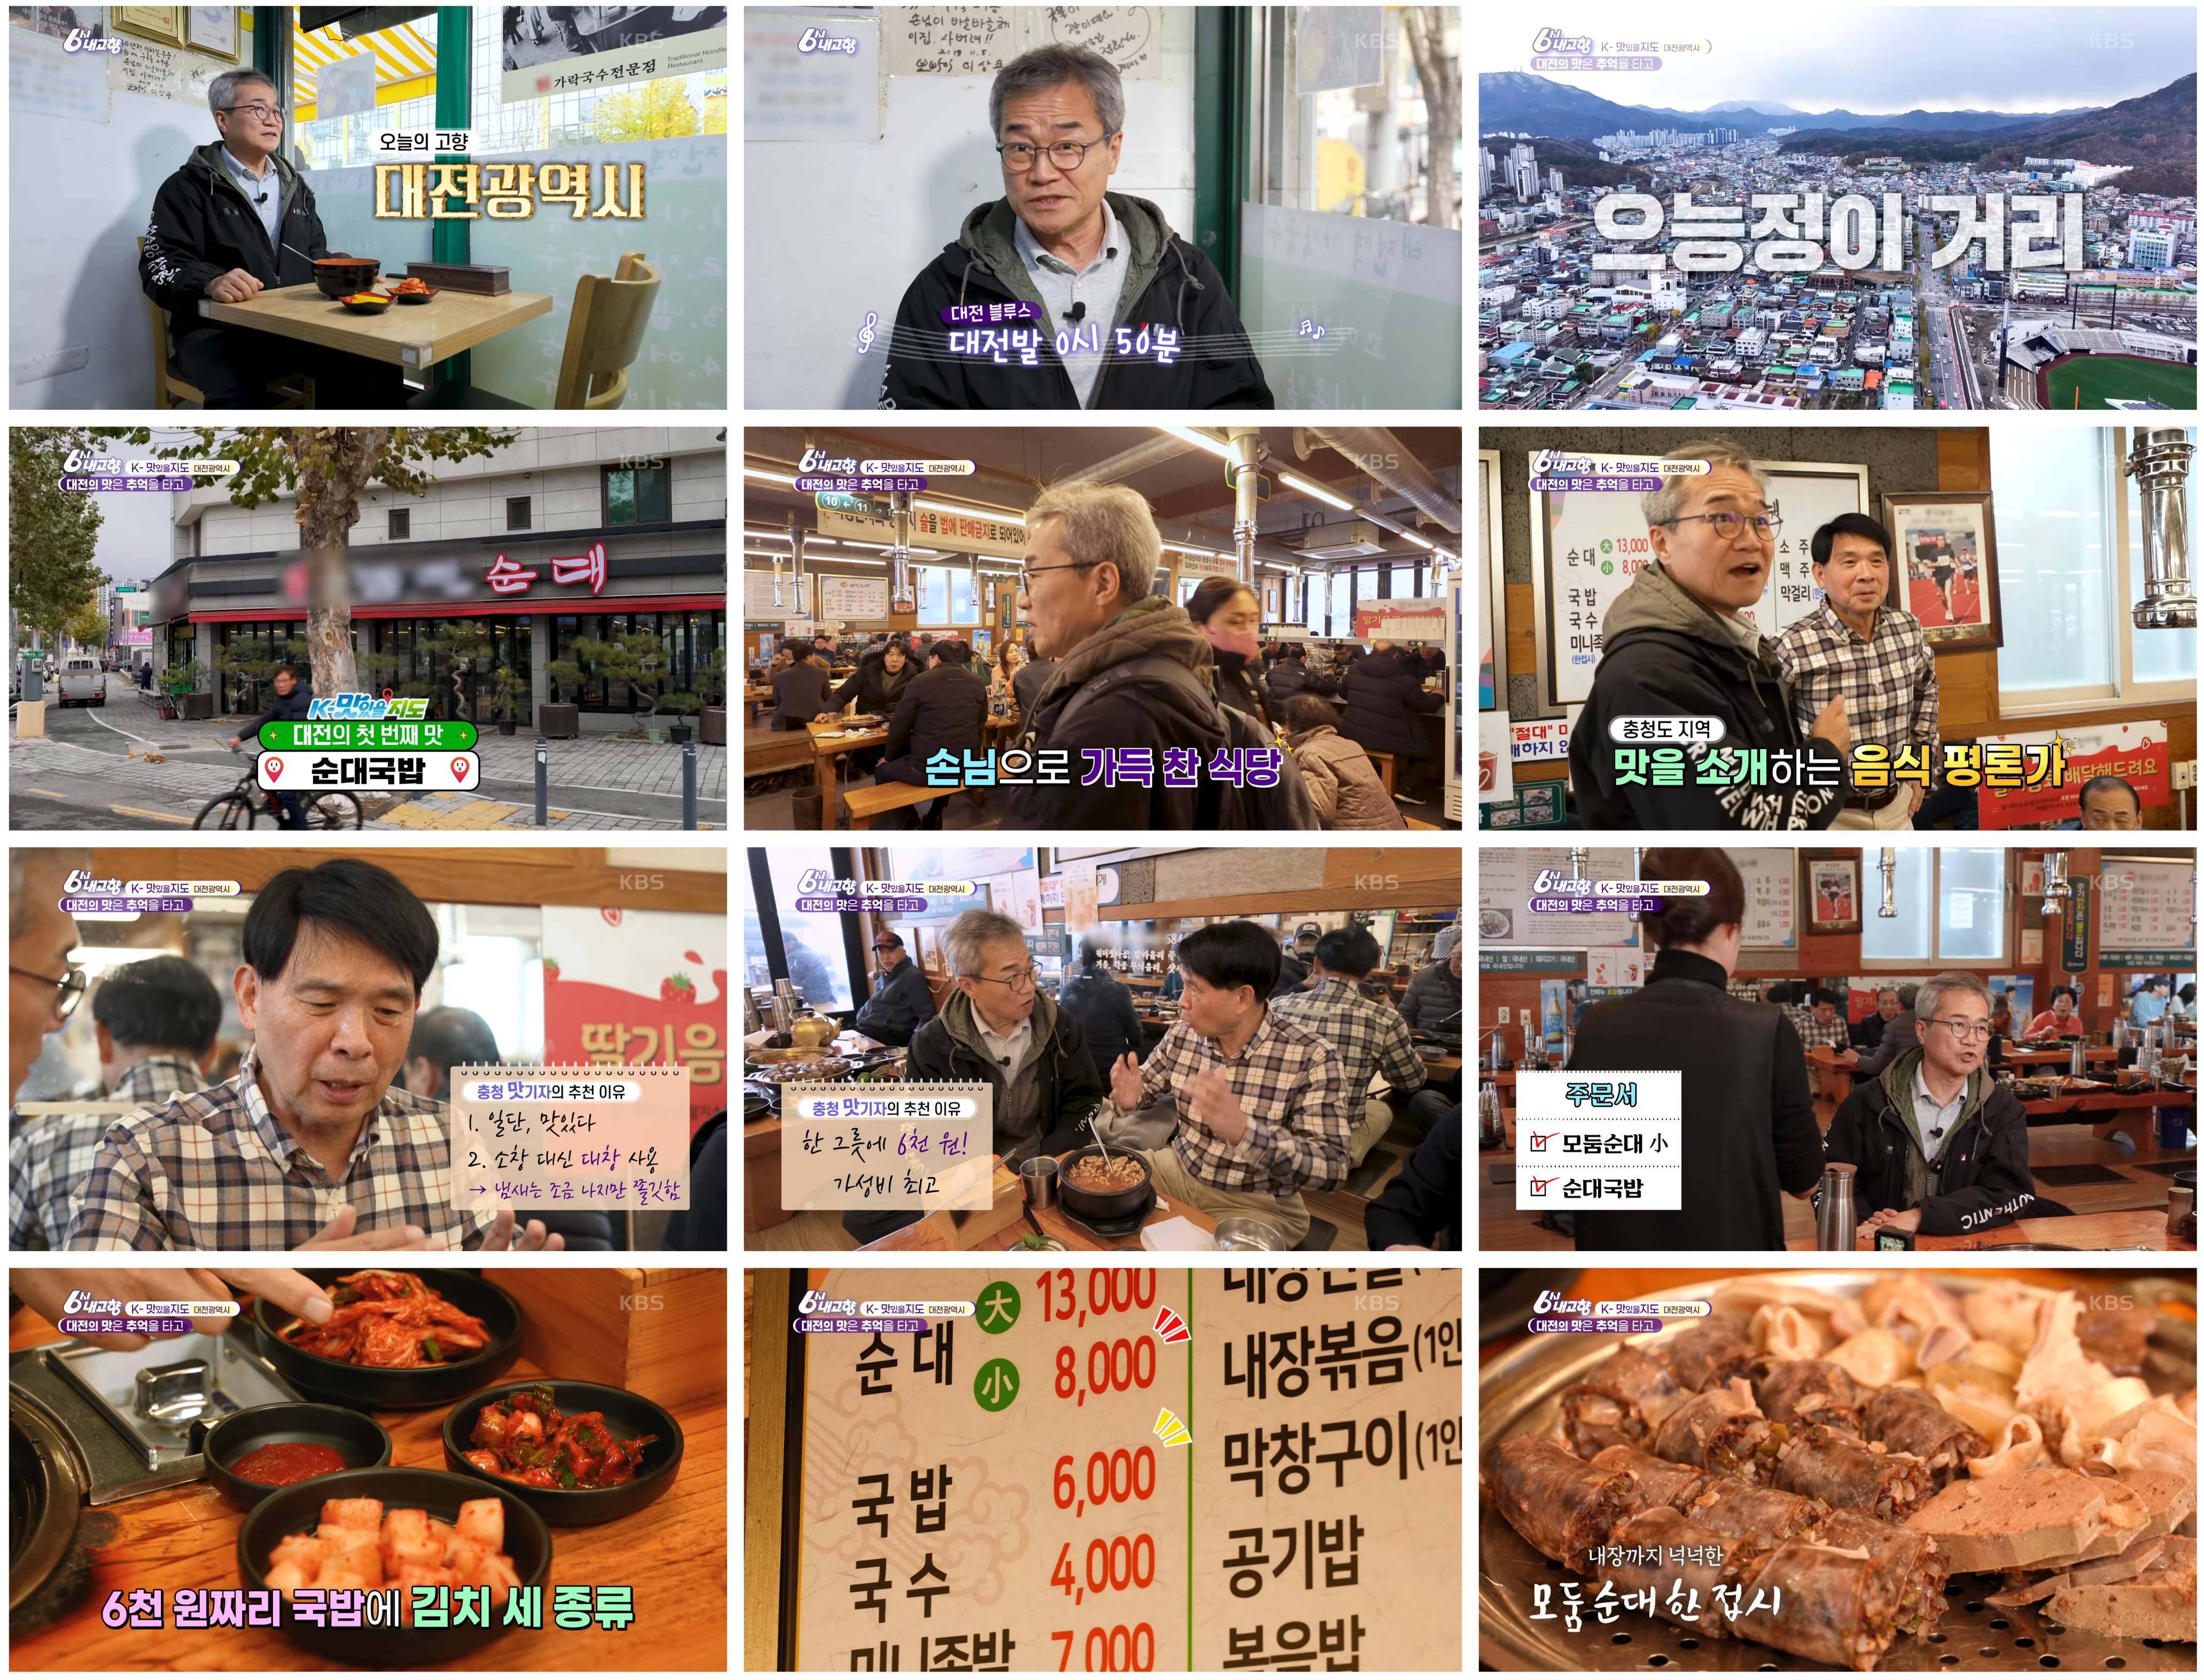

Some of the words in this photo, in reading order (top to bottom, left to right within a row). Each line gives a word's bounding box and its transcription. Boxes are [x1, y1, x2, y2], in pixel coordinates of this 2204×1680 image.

[909, 13, 944, 27] 손님이
[951, 16, 1010, 32] 바글바글해
[667, 52, 700, 62] Traditional
[703, 47, 727, 56] Noodle
[668, 58, 703, 68] Restaurant
[554, 58, 656, 89] 가락국수전문점
[825, 495, 838, 505] 10
[857, 503, 867, 512] 11
[920, 513, 937, 534] 술을
[940, 515, 956, 535] 법에
[960, 518, 997, 541] 판매금지로
[1617, 538, 1648, 554] 13,000
[1781, 585, 1810, 602] 막걸리
[1572, 654, 1595, 665] (한접시)
[1036, 1268, 1156, 1328] 13,000
[1054, 1335, 1156, 1407] 8,000
[1224, 1315, 1409, 1400] 내장볶음
[1224, 1410, 1407, 1497] 막창구이
[1053, 1445, 1156, 1518] 6,000
[1050, 1533, 1155, 1606] 4,000
[1222, 1514, 1365, 1598] 공기밥
